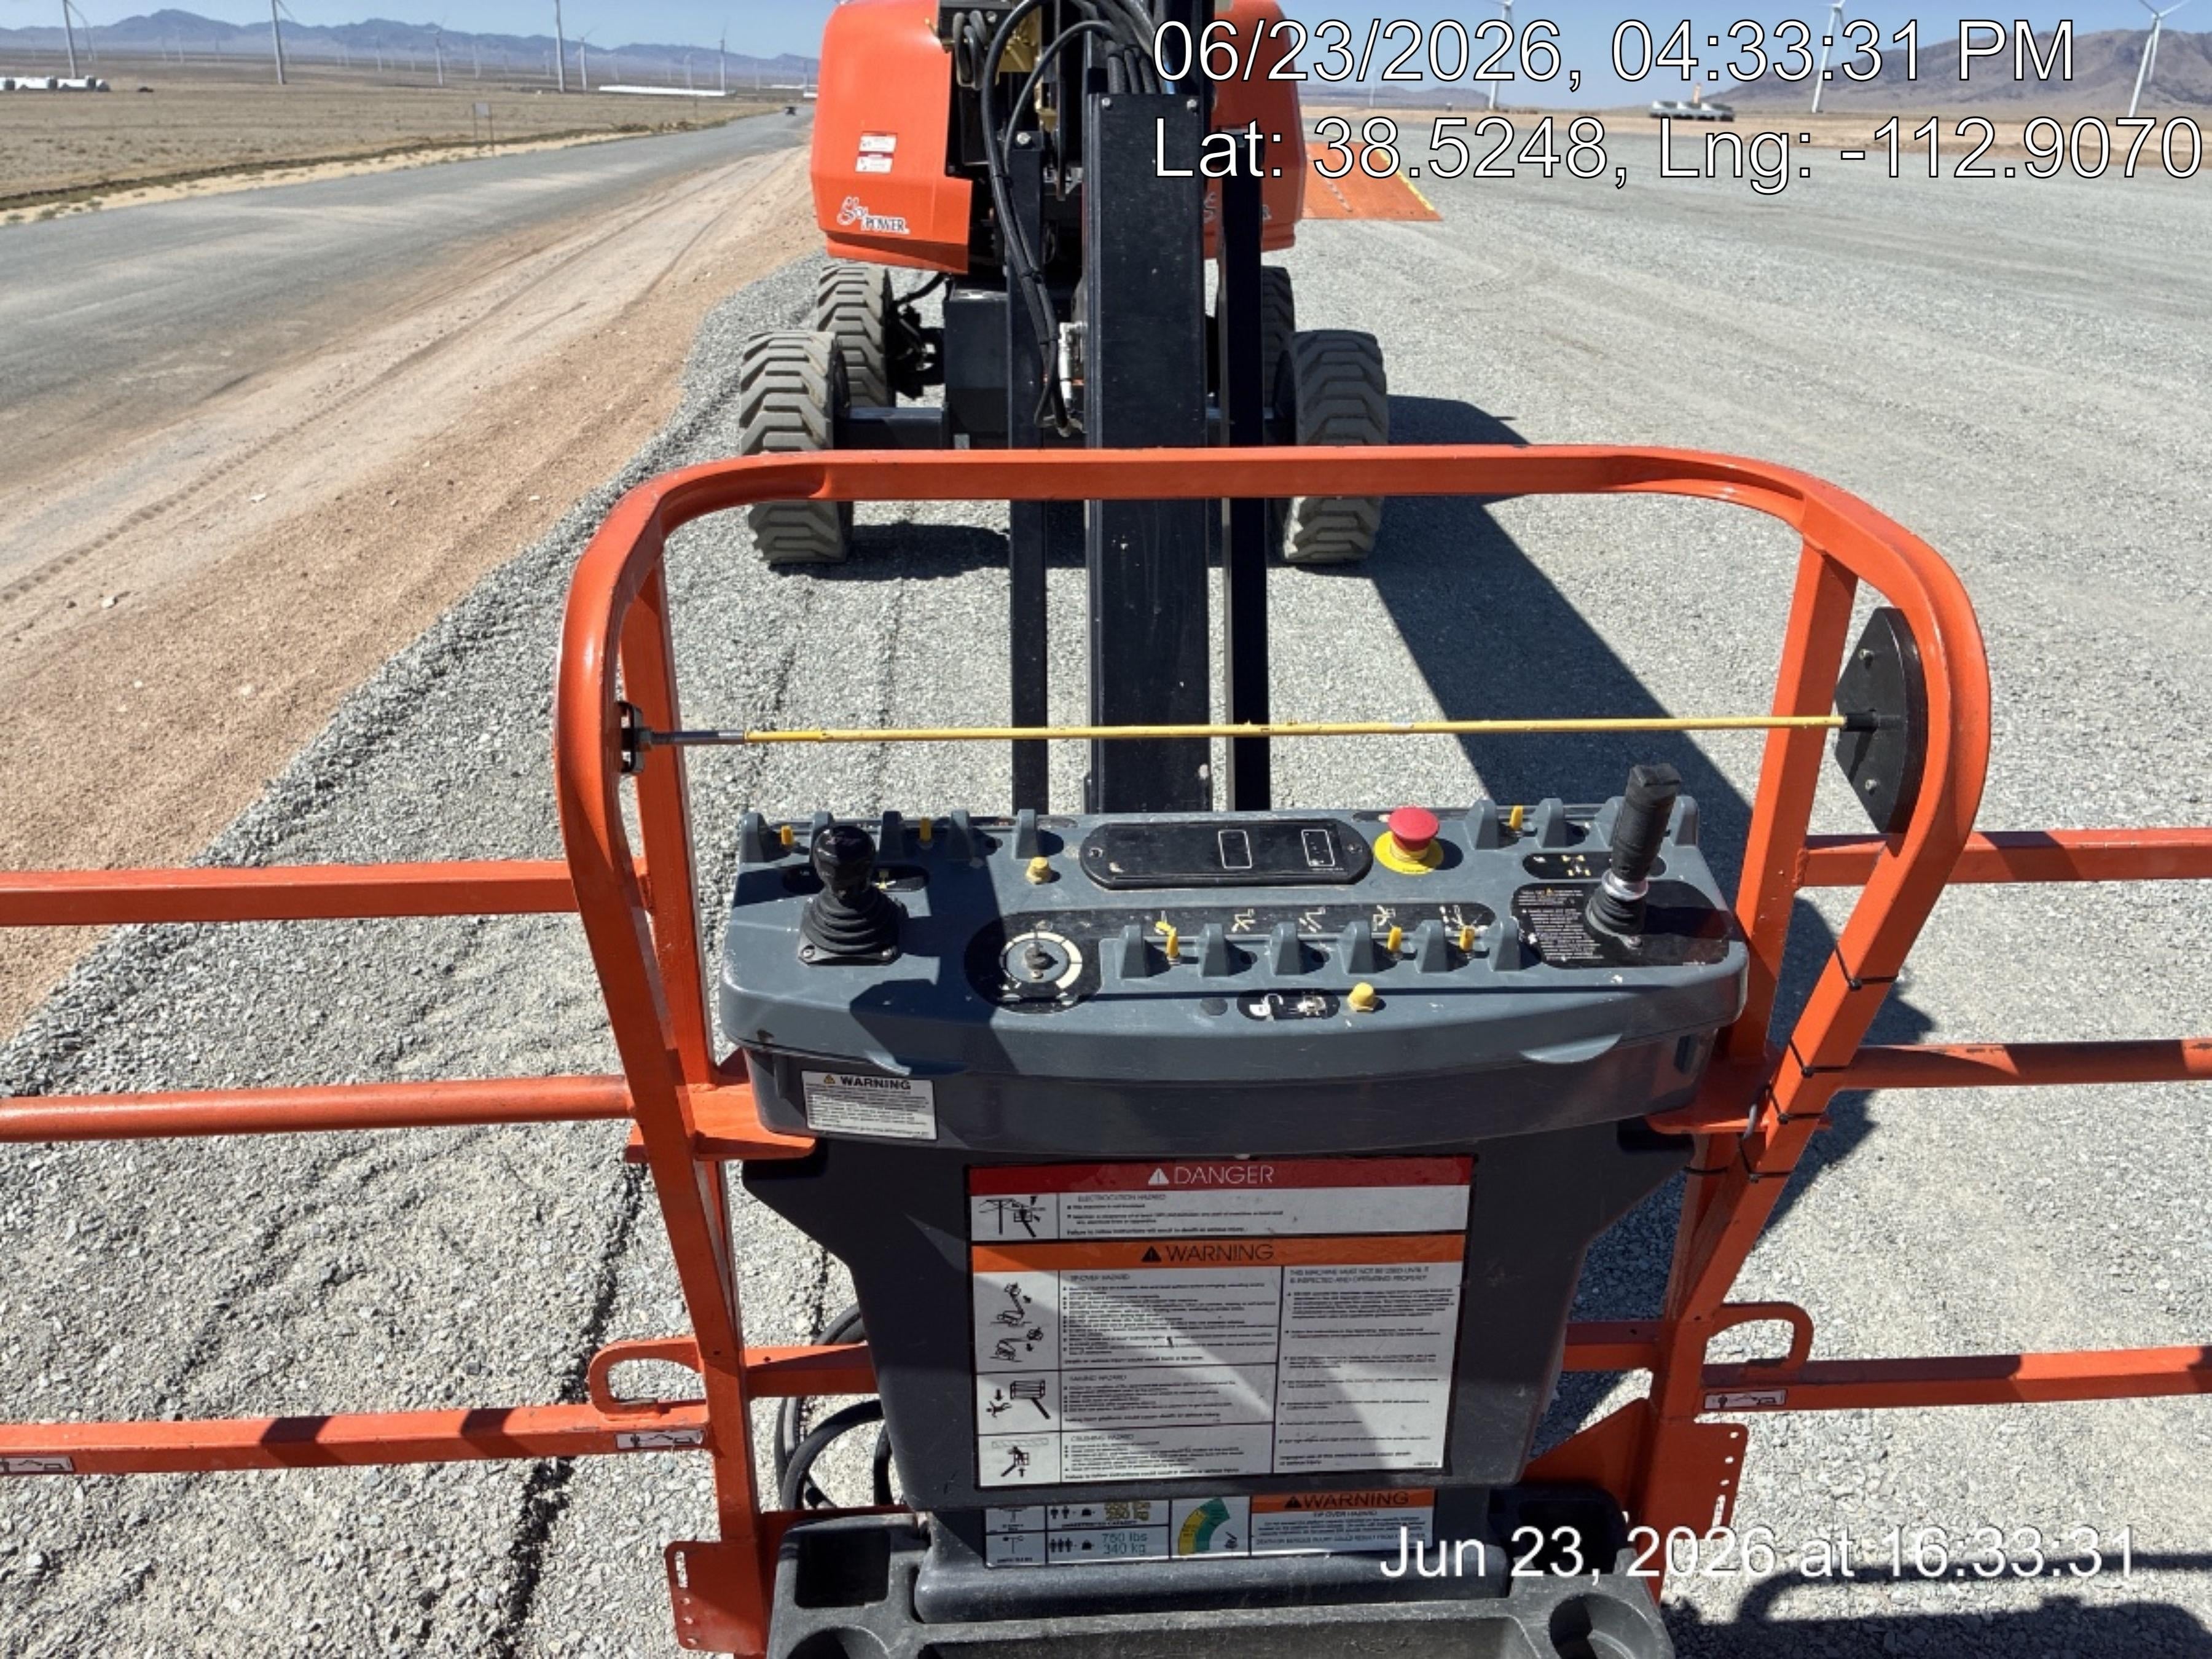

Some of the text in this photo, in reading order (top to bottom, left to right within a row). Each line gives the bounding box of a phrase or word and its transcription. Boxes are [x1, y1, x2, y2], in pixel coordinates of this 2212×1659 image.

[840, 1075, 911, 1090] WARNING
[1174, 1166, 1274, 1185] DANGER
[1165, 1243, 1274, 1262] WARNING
[1304, 1491, 1408, 1508] WARNING
[1130, 1532, 1147, 1542] lbs
[1132, 1542, 1146, 1556] kg
